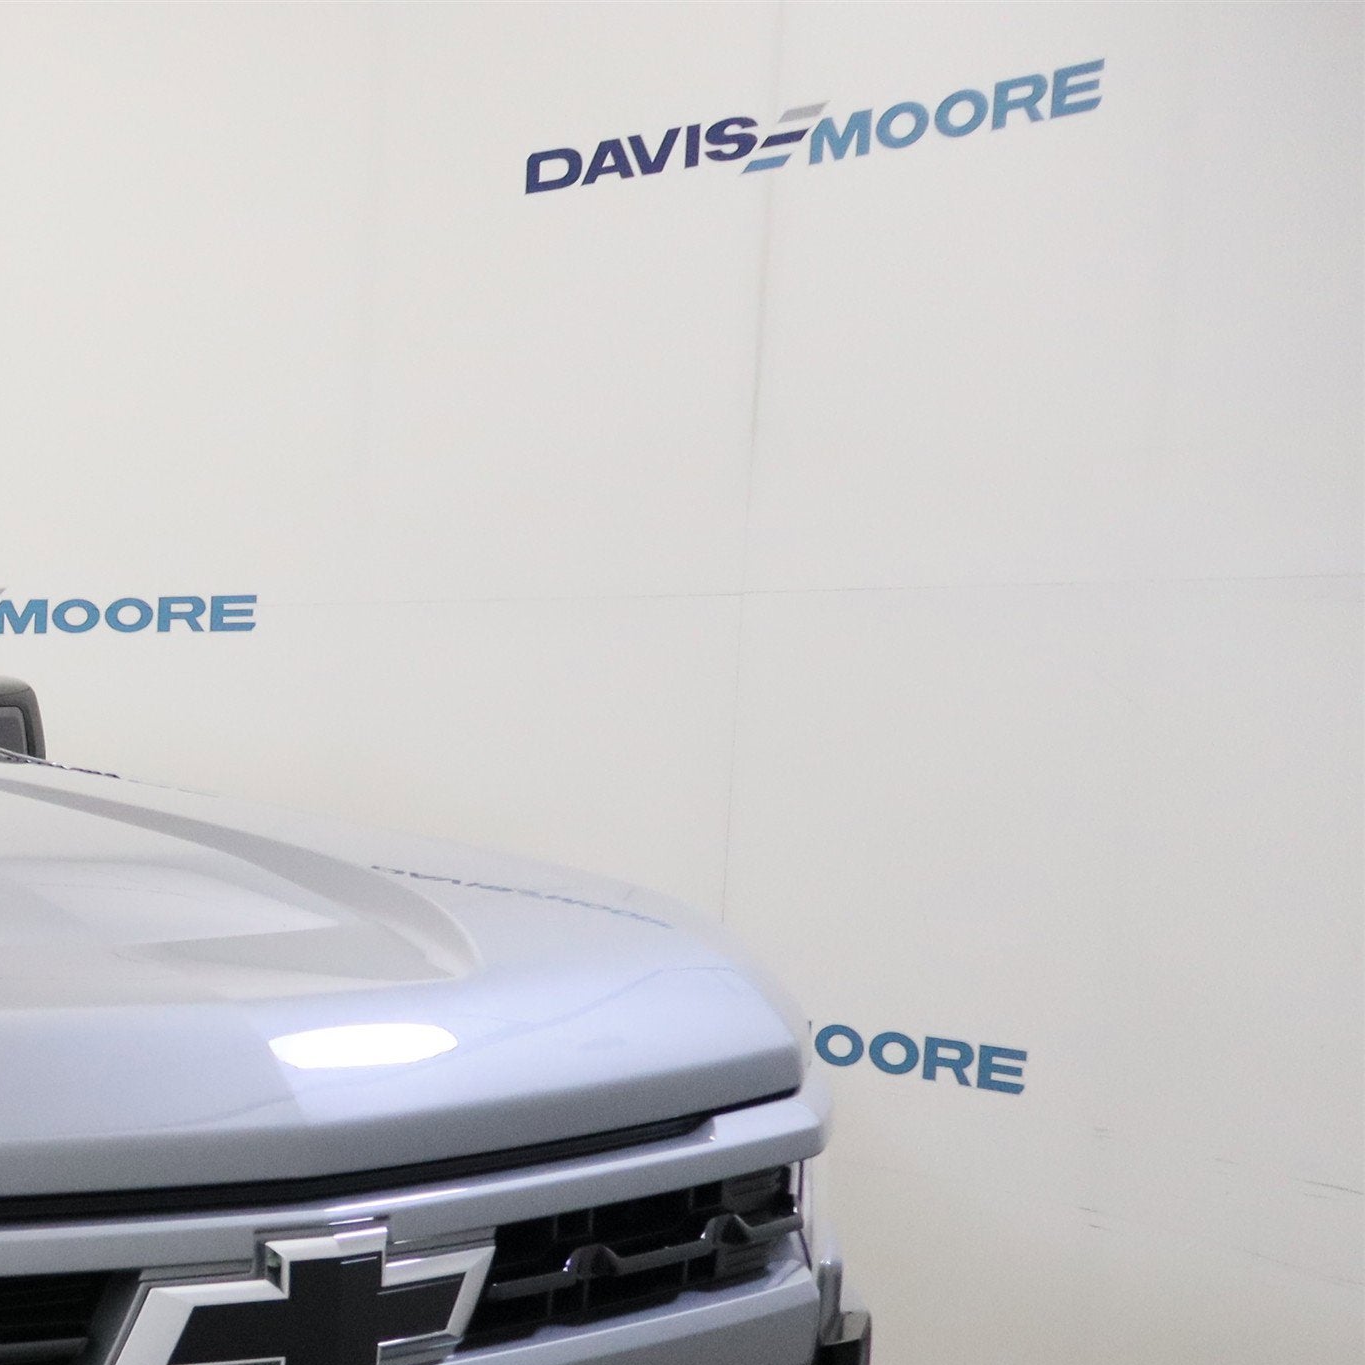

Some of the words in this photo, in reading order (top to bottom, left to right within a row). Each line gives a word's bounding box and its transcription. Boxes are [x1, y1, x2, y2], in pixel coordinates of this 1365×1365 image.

[524, 116, 758, 195] DAVIS
[808, 57, 1106, 165] MOORE
[814, 1023, 1028, 1096] OORE
